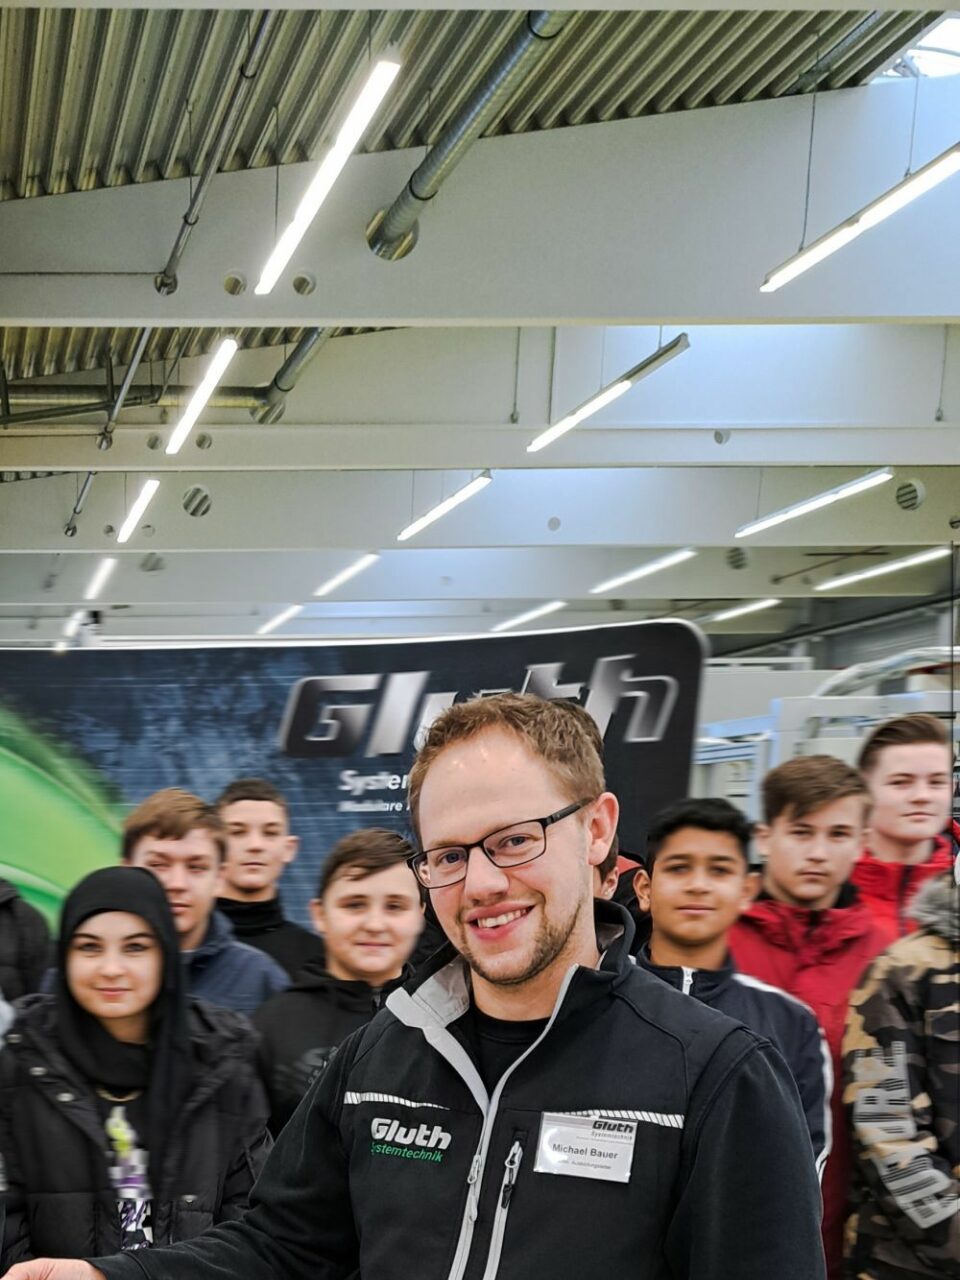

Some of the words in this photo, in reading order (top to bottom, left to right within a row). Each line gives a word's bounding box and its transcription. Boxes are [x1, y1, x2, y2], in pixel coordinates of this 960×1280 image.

[371, 1117, 452, 1150] Gluth
[592, 1120, 634, 1133] Gluth
[552, 1143, 588, 1155] Michael
[589, 1148, 619, 1160] Bauer
